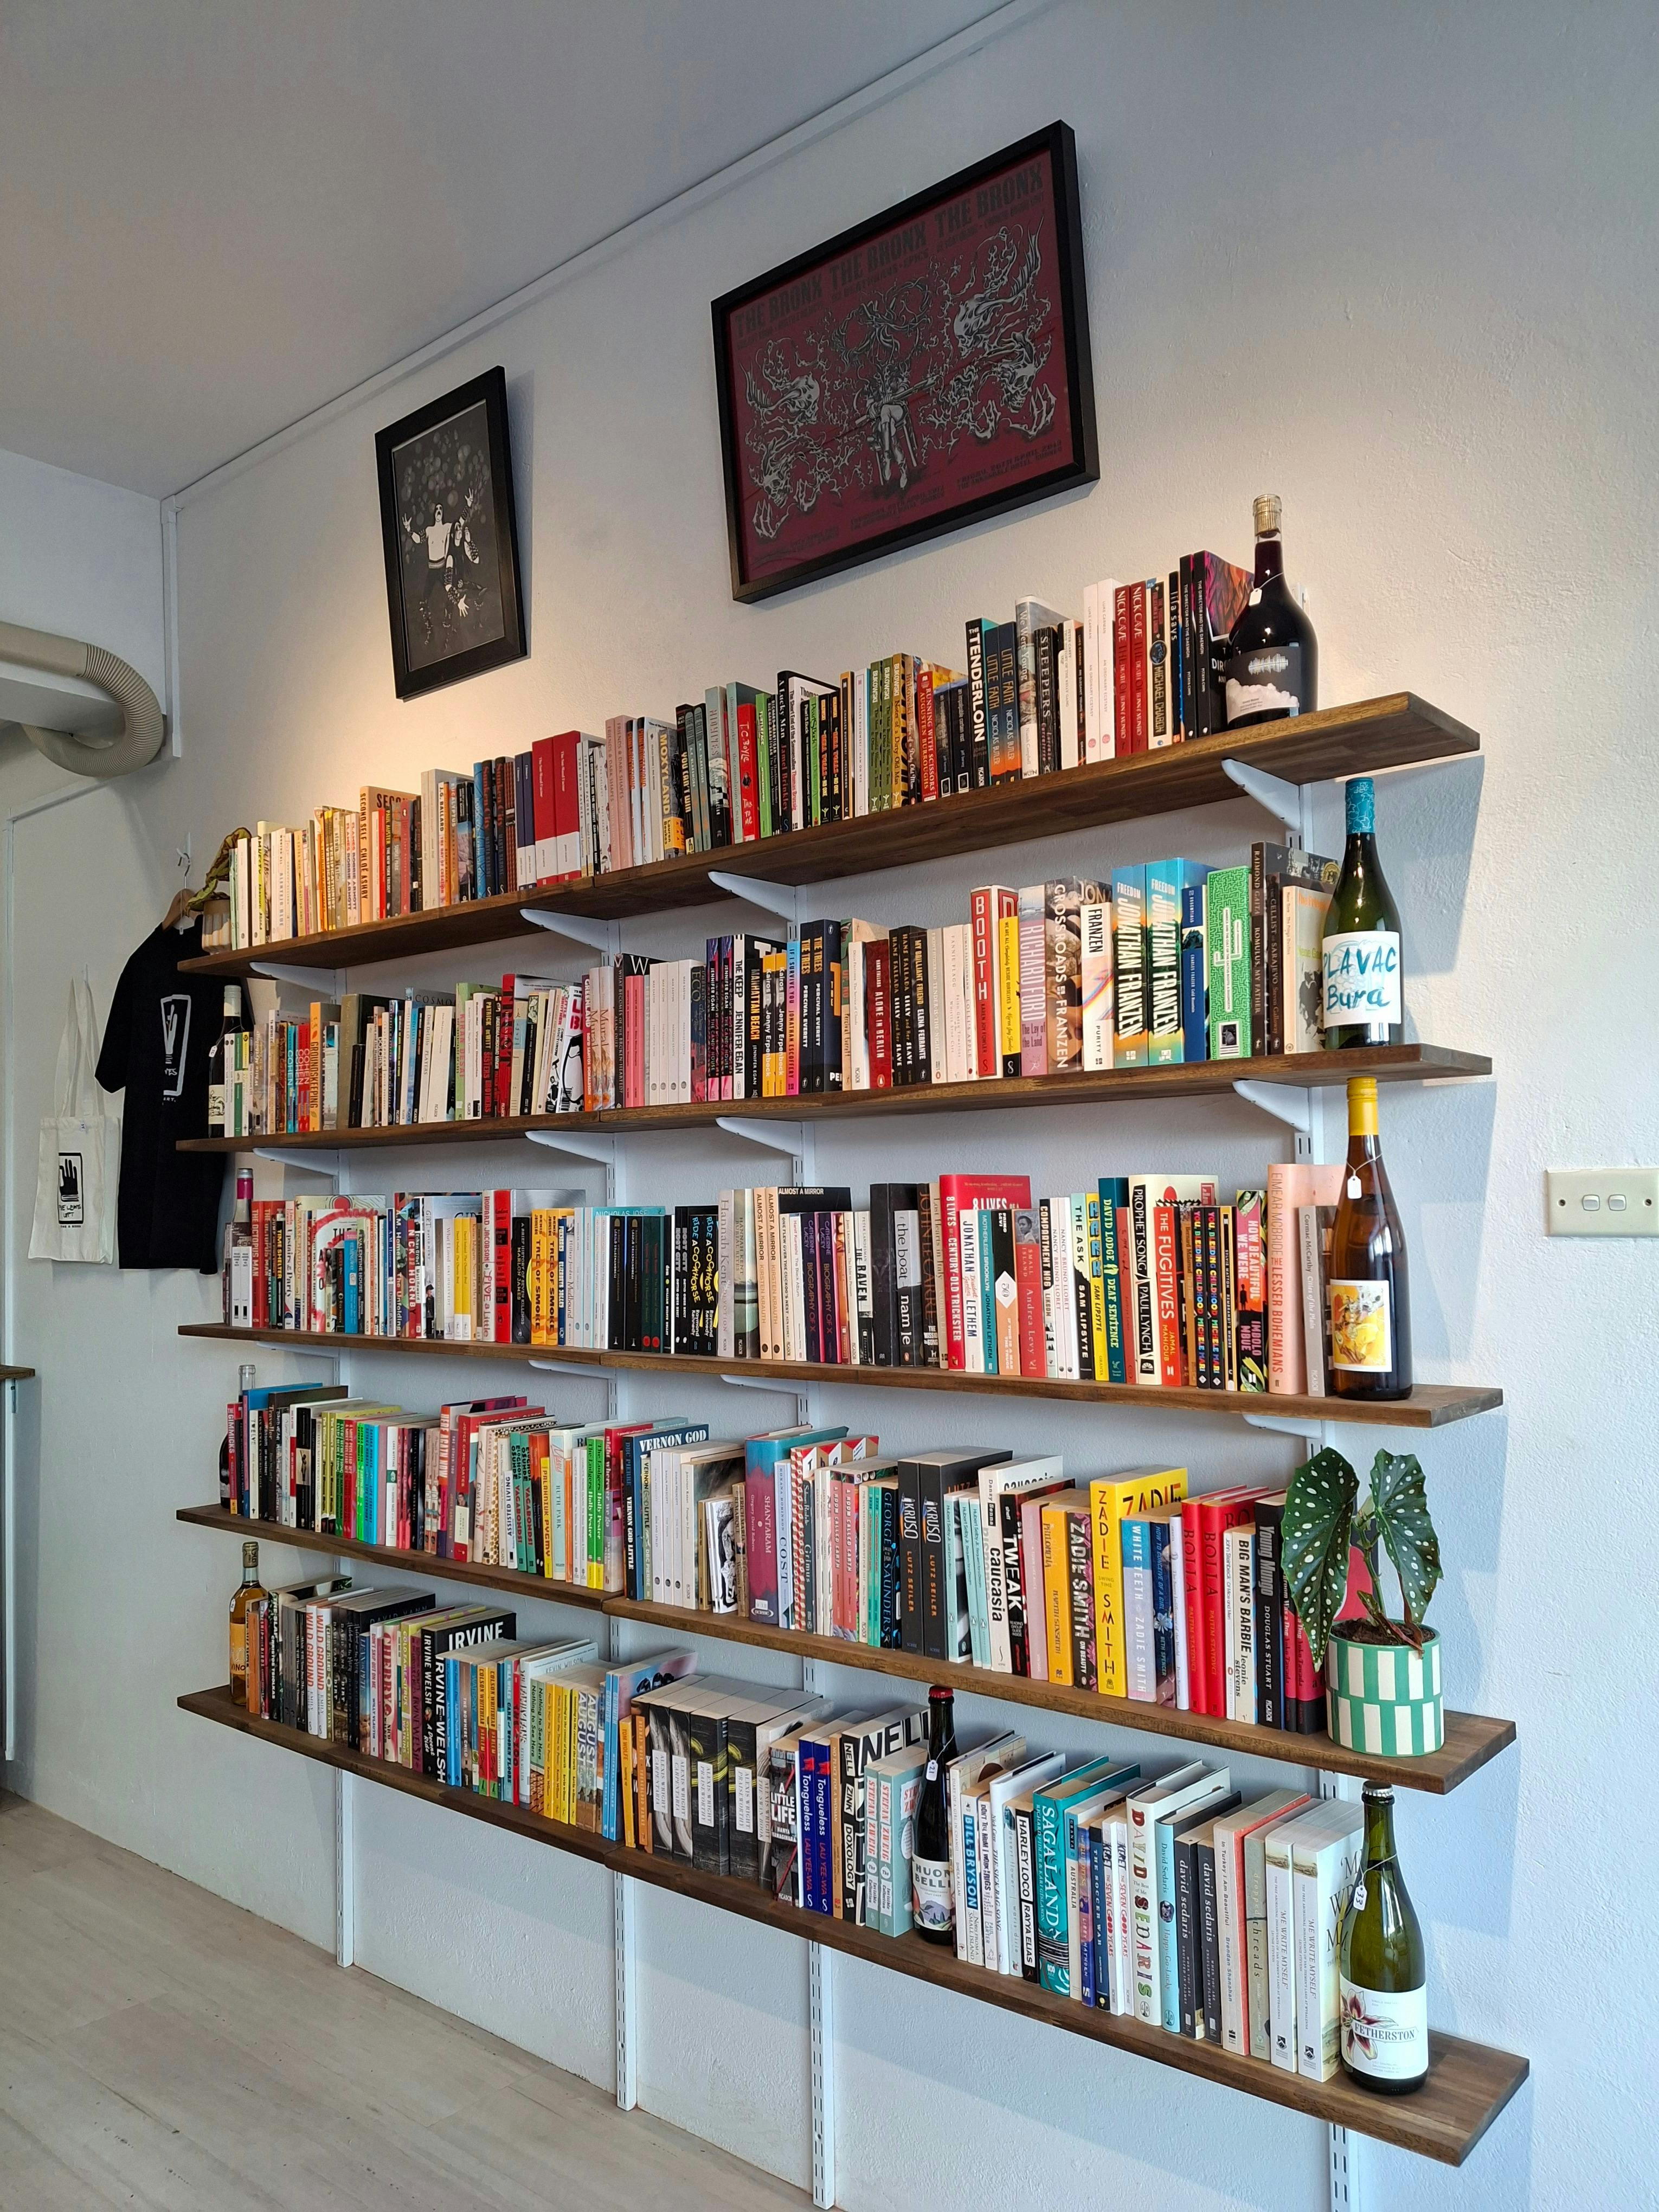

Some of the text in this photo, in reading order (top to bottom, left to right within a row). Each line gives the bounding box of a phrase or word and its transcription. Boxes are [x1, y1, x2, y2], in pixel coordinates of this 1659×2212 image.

[934, 197, 970, 236] THE
[978, 164, 1043, 216] BRONX
[829, 255, 863, 287] THE
[869, 223, 926, 270] BRONX
[735, 301, 765, 338] THE
[769, 276, 823, 323] BRONX
[1020, 610, 1027, 623] We
[1117, 590, 1126, 642] NICK CAVE
[1133, 586, 1142, 639] NICK CAVE
[969, 634, 985, 742] TENDERLOIN
[1001, 649, 1012, 677] LITTLE
[1040, 636, 1050, 718] SLEEPERS
[1004, 679, 1014, 704] FAITH
[1155, 666, 1165, 733] MICHAEL CHABON
[659, 734, 670, 814] MOXYLAND
[1117, 882, 1140, 898] FREEDOM
[1152, 879, 1175, 895] FREEDOM
[801, 939, 810, 954] THE
[976, 896, 987, 1001] BOOTH
[1088, 909, 1103, 954] FRANZEN
[801, 955, 810, 975] TREES
[1020, 925, 1046, 1021] RICHARD FORD
[1054, 884, 1068, 1068] CROSSROADS FRANZEN
[1117, 898, 1143, 1040] JONATHAN FRANZEN
[1152, 896, 1178, 1039] JONATHAN FRANZEN
[735, 1011, 743, 1049] JENNIFER
[876, 1018, 884, 1027] IN
[876, 1031, 884, 1058] BERLIN
[310, 1042, 318, 1108] GROUNDSKEEPING
[735, 1051, 743, 1074] EGAN
[897, 1221, 908, 1280] the boat
[1134, 1189, 1151, 1352] PROPHET SONG PAUL LYNCH
[1159, 1213, 1175, 1321] THE FUGITIVES
[1237, 1235, 1248, 1279] WE WERE
[1248, 1239, 1261, 1300] BEAUTIFUL
[1271, 1173, 1283, 1374] EIMEAR MCBRIDE THE LESSER BOHEMIANS
[963, 1221, 977, 1337] JONATHAN LETHEM
[901, 1295, 910, 1346] nam le
[1080, 1312, 1088, 1359] LIPSYTE
[1240, 1325, 1251, 1351] MBUE
[1251, 1321, 1262, 1355] IMBOLO
[639, 1430, 706, 1452] VERNON GOD
[904, 1502, 918, 1540] KRUSO
[926, 1504, 941, 1544] KRUSO
[990, 1548, 1002, 1622] caucasia
[1004, 1537, 1022, 1611] TWEAK
[1070, 1522, 1090, 1638] ZADIE SMITH
[1204, 1533, 1218, 1597] BOLLA
[1259, 1526, 1275, 1596] Young Mungo
[1239, 1540, 1251, 1652] BIG MAN'S BARBIE
[435, 1656, 446, 1783] IRVINE WELSH
[771, 1794, 795, 1808] LITTLE
[779, 1783, 785, 1793] A
[816, 1779, 827, 1836] Tongueless
[771, 1807, 795, 1825] LIFE
[1019, 1819, 1027, 1861] HARLEY
[1131, 1809, 1146, 1879] DAVID
[966, 1848, 976, 1907] BRYSON
[1021, 1864, 1030, 1897] LOCO
[1204, 1862, 1213, 1896] david
[1356, 1892, 1364, 1904] 33
[1135, 1894, 1152, 1998] SEDARIS
[1355, 2023, 1415, 2040] FETHERSTON
